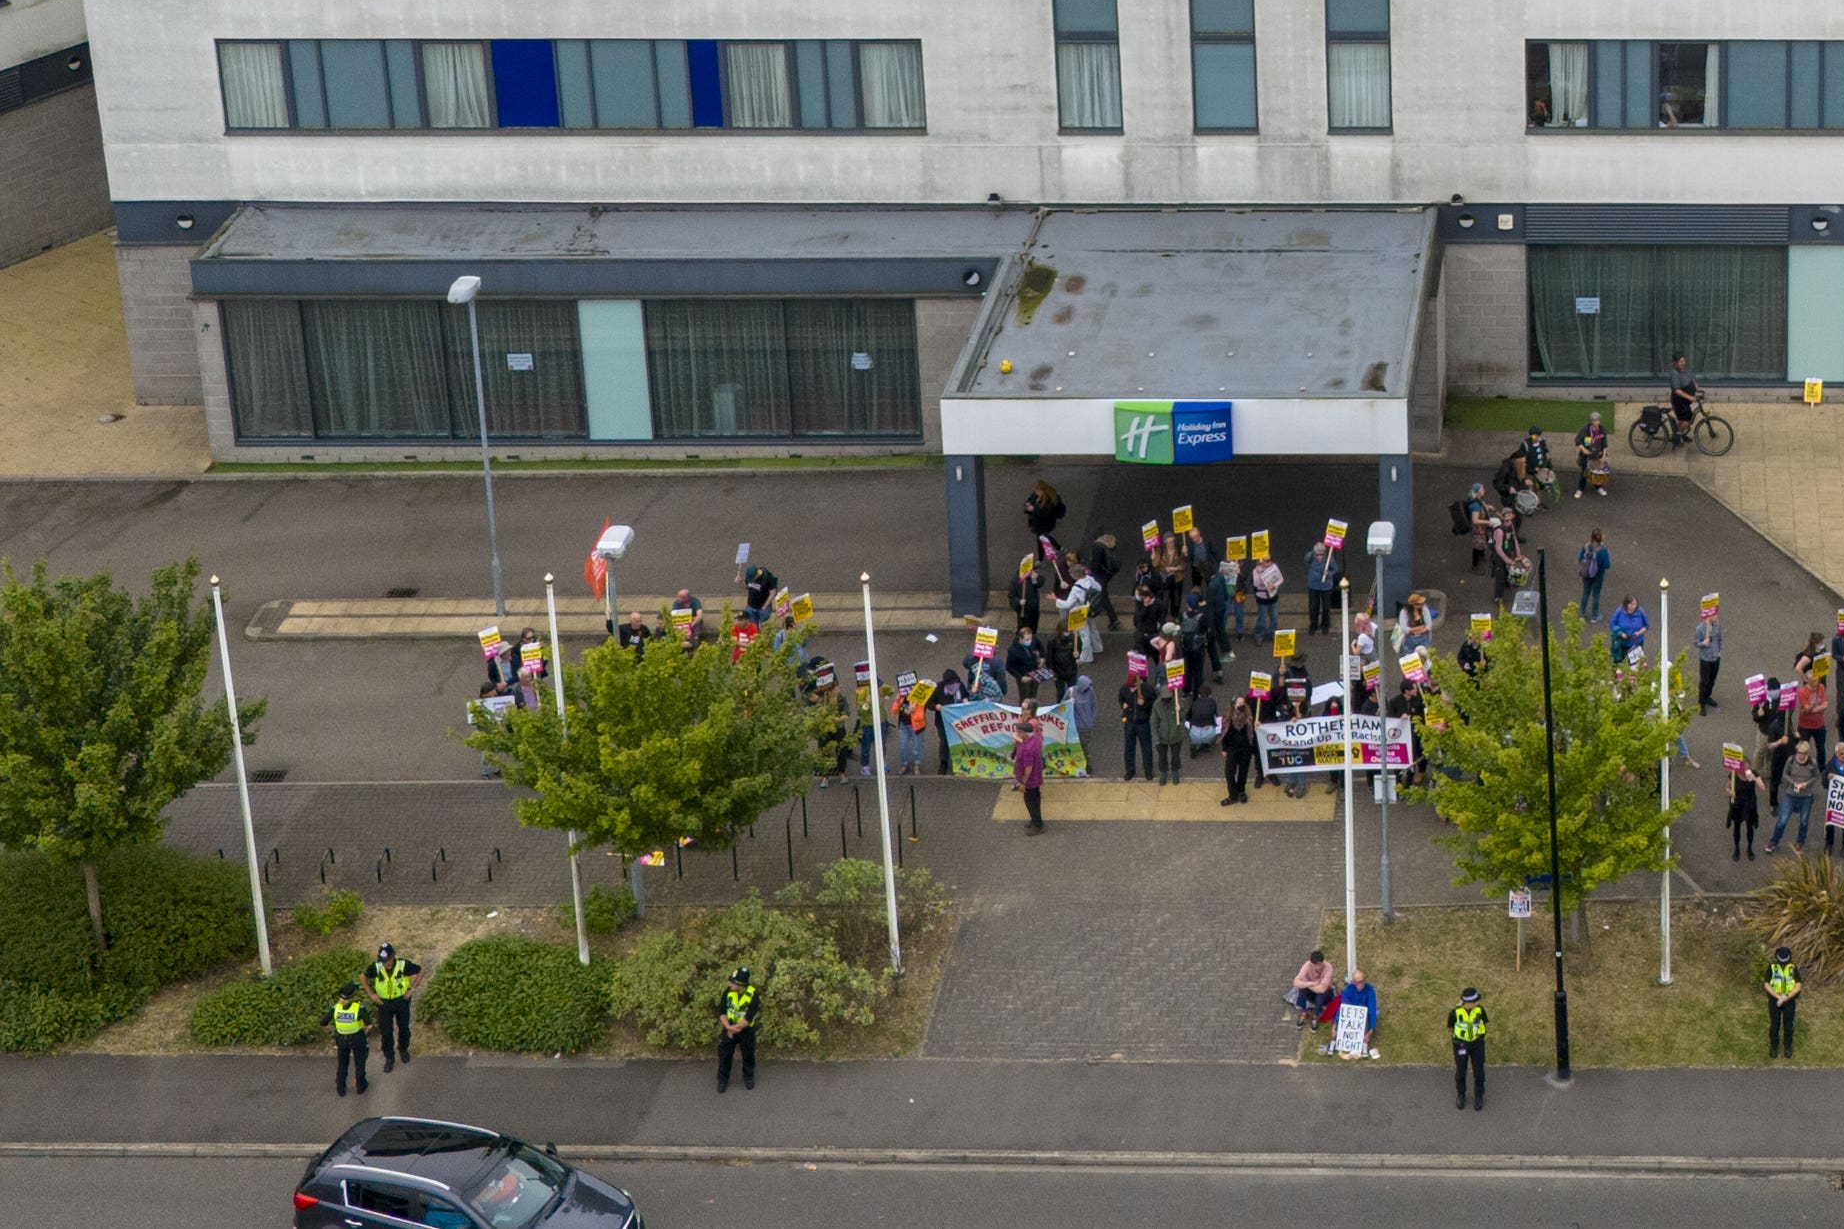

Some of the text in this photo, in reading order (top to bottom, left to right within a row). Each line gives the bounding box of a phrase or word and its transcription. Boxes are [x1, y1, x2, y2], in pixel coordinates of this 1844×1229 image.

[1177, 421, 1227, 432] Holiday Inn
[1178, 432, 1226, 446] Express
[954, 711, 1008, 732] SHEFFIELD
[1282, 736, 1314, 747] Stand
[1317, 734, 1332, 744] Up
[1341, 1007, 1365, 1020] LETS
[1340, 1019, 1364, 1030] TALK
[1343, 1031, 1360, 1041] NOT
[1337, 1039, 1361, 1050] FIGHT
